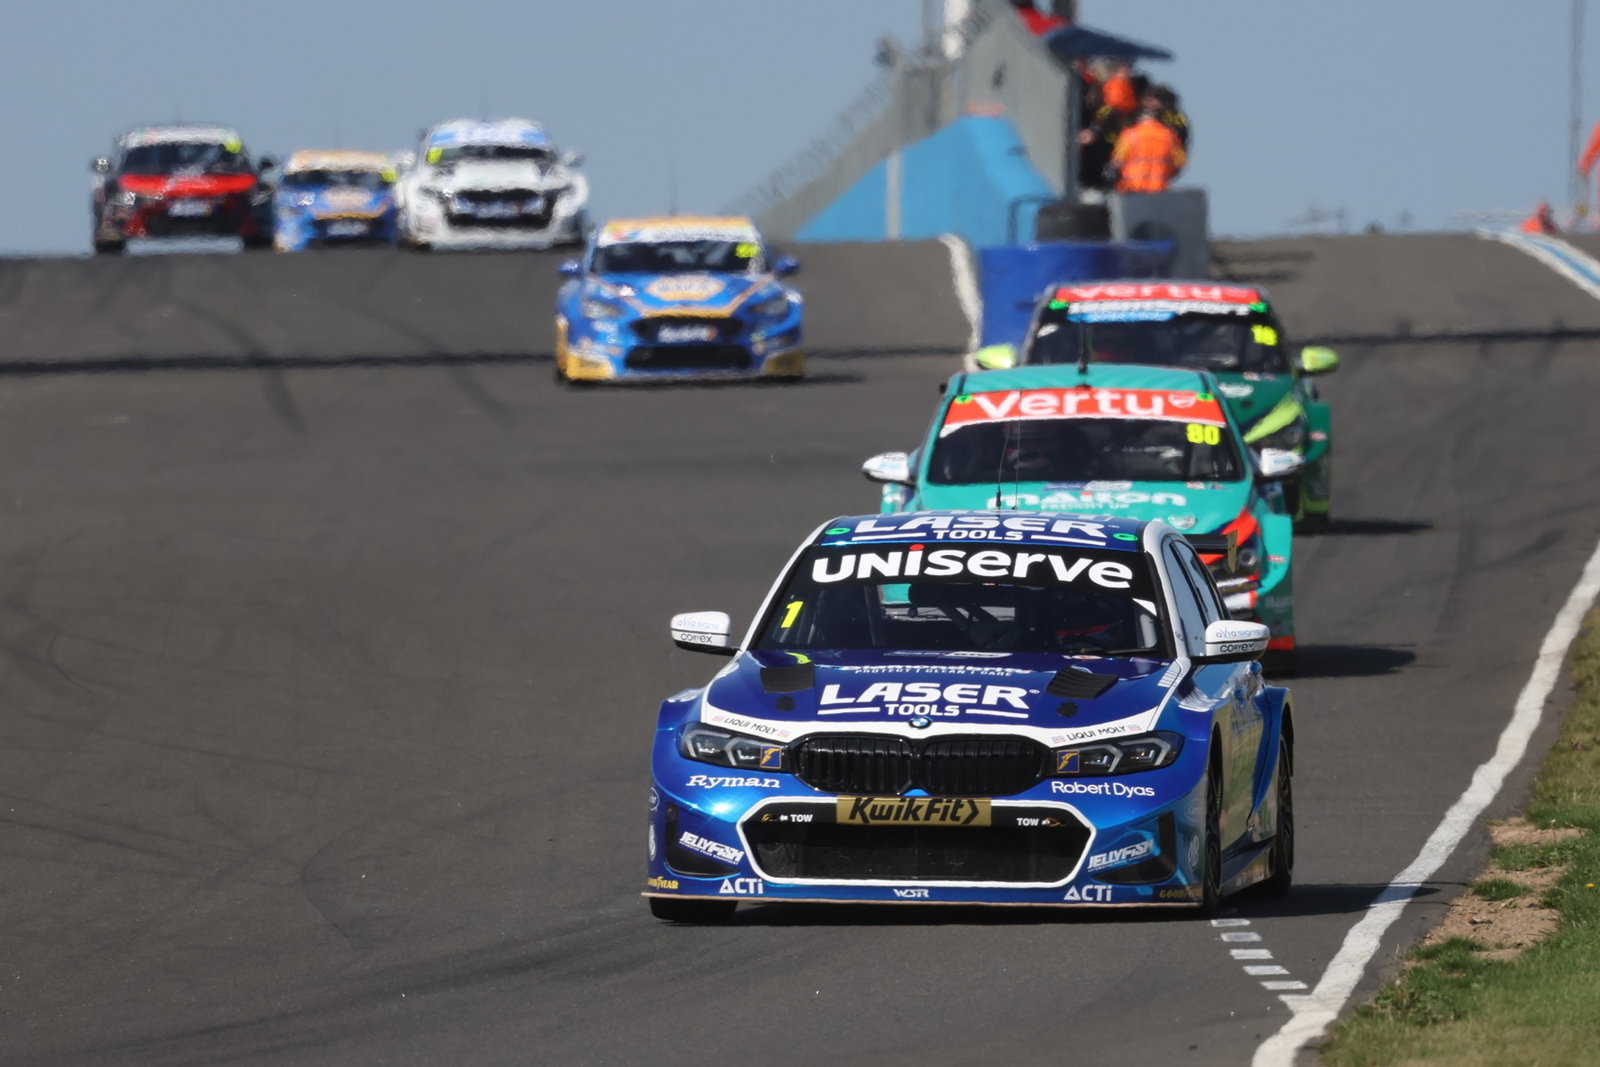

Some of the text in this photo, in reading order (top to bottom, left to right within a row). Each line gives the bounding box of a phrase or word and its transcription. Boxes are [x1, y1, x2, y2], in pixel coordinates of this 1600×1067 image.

[973, 389, 1164, 418] vertu
[1185, 423, 1220, 446] 80
[854, 515, 1108, 538] LASER
[933, 529, 1024, 542] TOOLS
[780, 601, 804, 628] 1
[820, 682, 1030, 709] LASER
[885, 703, 960, 716] TOOLS
[724, 717, 777, 735] LIQUI MOLY
[1067, 725, 1126, 741] LIQUI MOLY
[686, 774, 781, 789] Ryman
[1051, 781, 1155, 798] Robert Dyas
[790, 814, 813, 823] TOW
[1017, 817, 1039, 826] TOW
